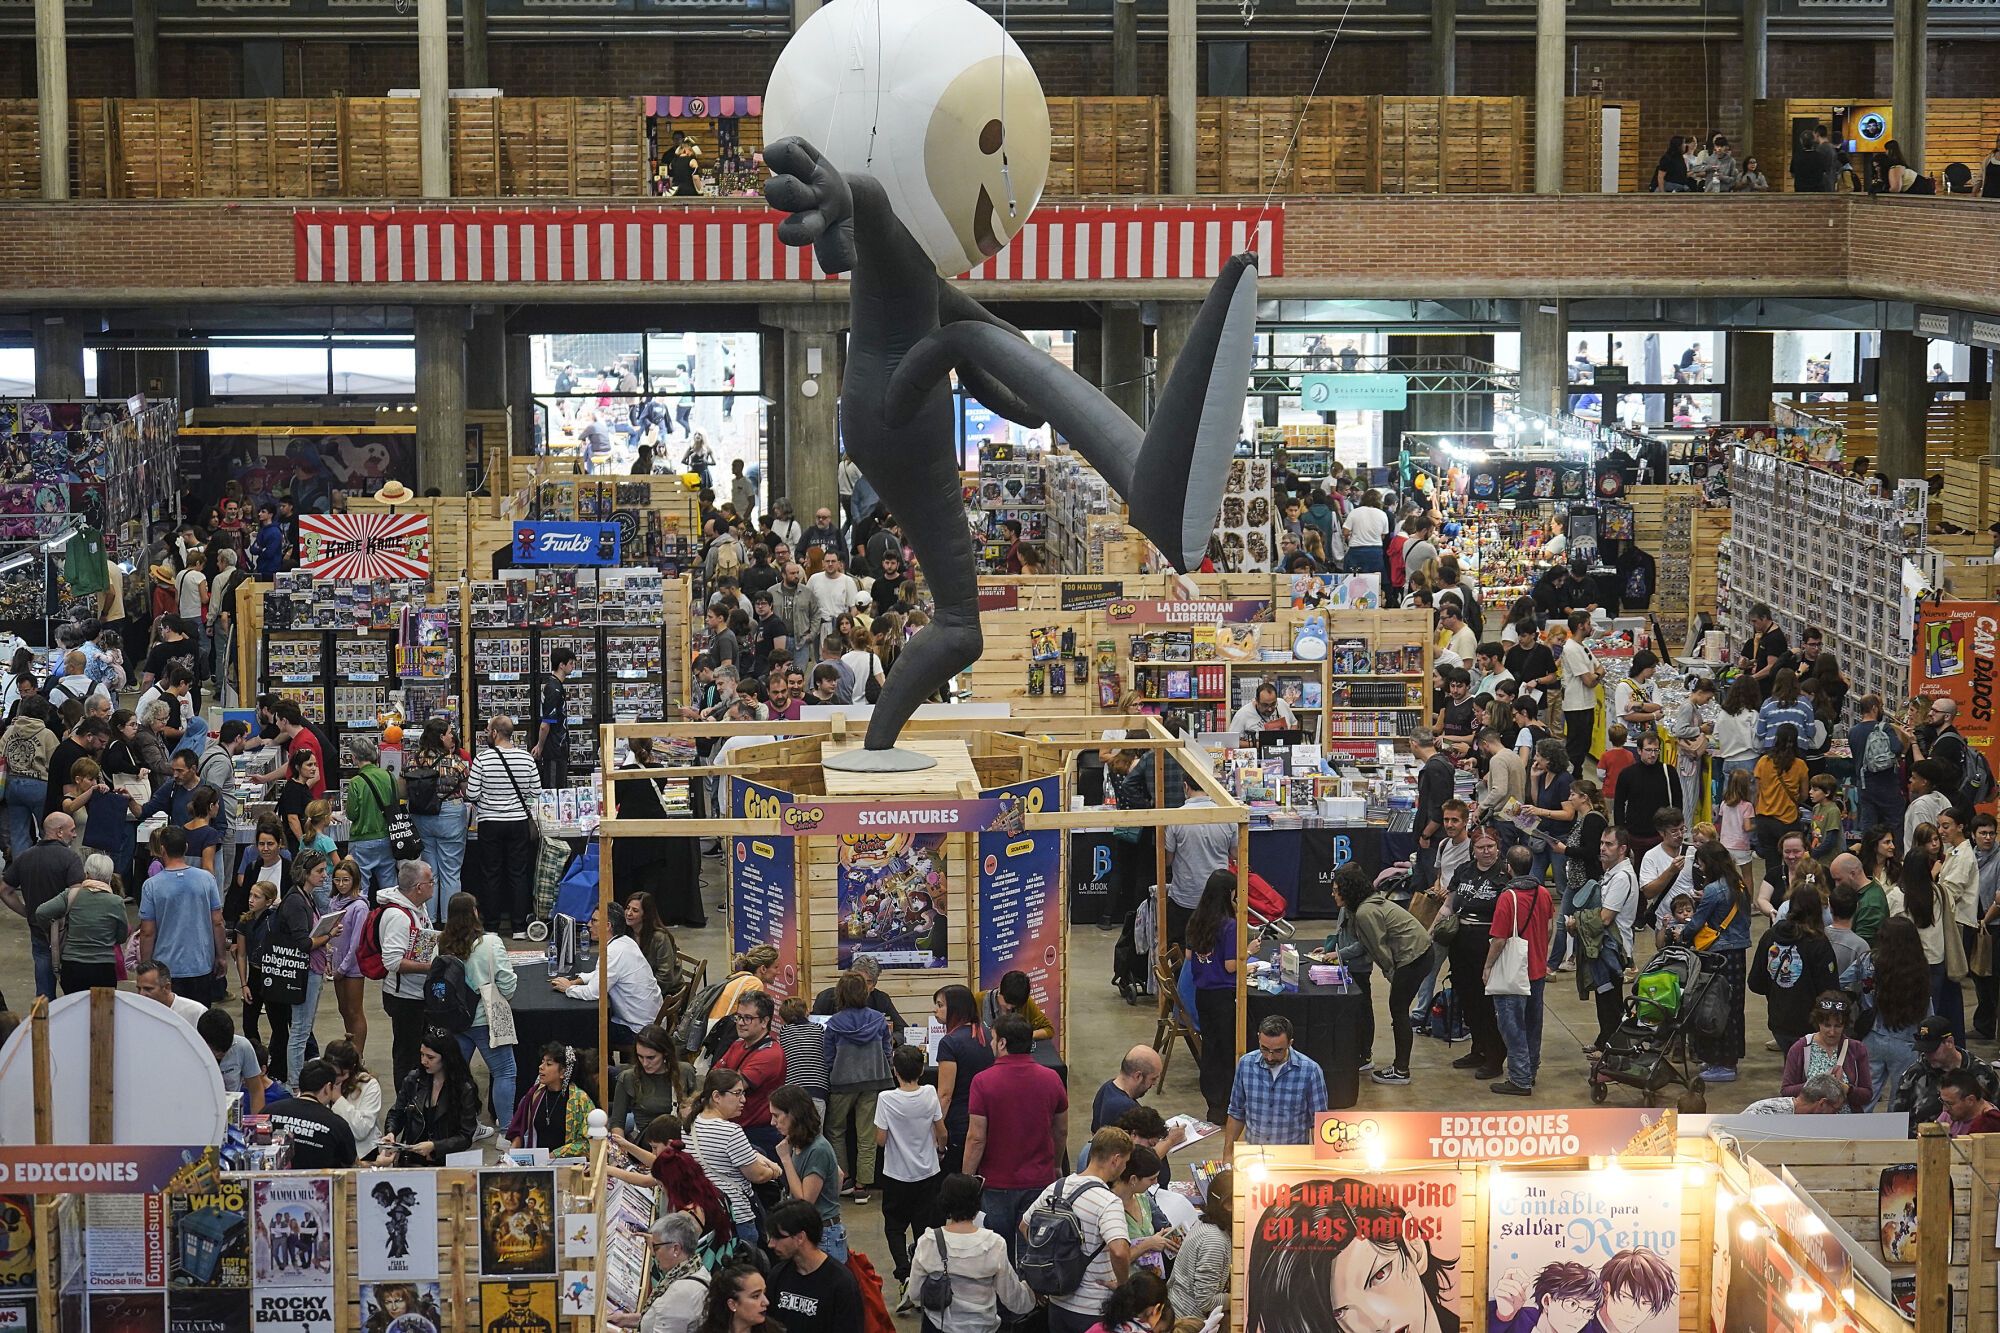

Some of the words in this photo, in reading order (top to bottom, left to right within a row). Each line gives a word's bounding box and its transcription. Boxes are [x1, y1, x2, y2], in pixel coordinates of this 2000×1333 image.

[540, 532, 592, 552] Funko
[1064, 583, 1076, 591] 100
[1077, 583, 1103, 591] HAIKUS
[1157, 602, 1171, 612] LA
[1173, 602, 1233, 612] BOOKMAN
[1166, 612, 1223, 623] LLIBRERIA
[1922, 610, 1947, 618] Nuevo
[1948, 611, 1976, 620] Juego!
[858, 809, 959, 825] SIGNATURES
[1078, 883, 1087, 891] LA
[284, 1123, 315, 1138] STORE
[1440, 1114, 1569, 1137] EDICIONES
[1429, 1133, 1580, 1158] TOMODOMO
[15, 1162, 139, 1183] EDICIONES
[270, 1190, 298, 1201] MAMMA
[299, 1188, 314, 1200] MIA!
[1525, 1186, 1546, 1199] Un
[190, 1194, 244, 1211] WHO
[1498, 1189, 1606, 1216] Contable
[1610, 1203, 1639, 1218] para
[146, 1192, 163, 1282] rainspotting
[1500, 1216, 1565, 1240] salvar
[1567, 1218, 1677, 1259] Reino
[1554, 1235, 1566, 1249] el
[222, 1258, 240, 1267] LOST
[222, 1266, 240, 1275] TIME
[90, 1277, 126, 1285] Choose
[128, 1277, 145, 1285] life.
[221, 1274, 248, 1284] SPACE!
[261, 1296, 327, 1310] ROCKY
[256, 1308, 332, 1322] BALBOA
